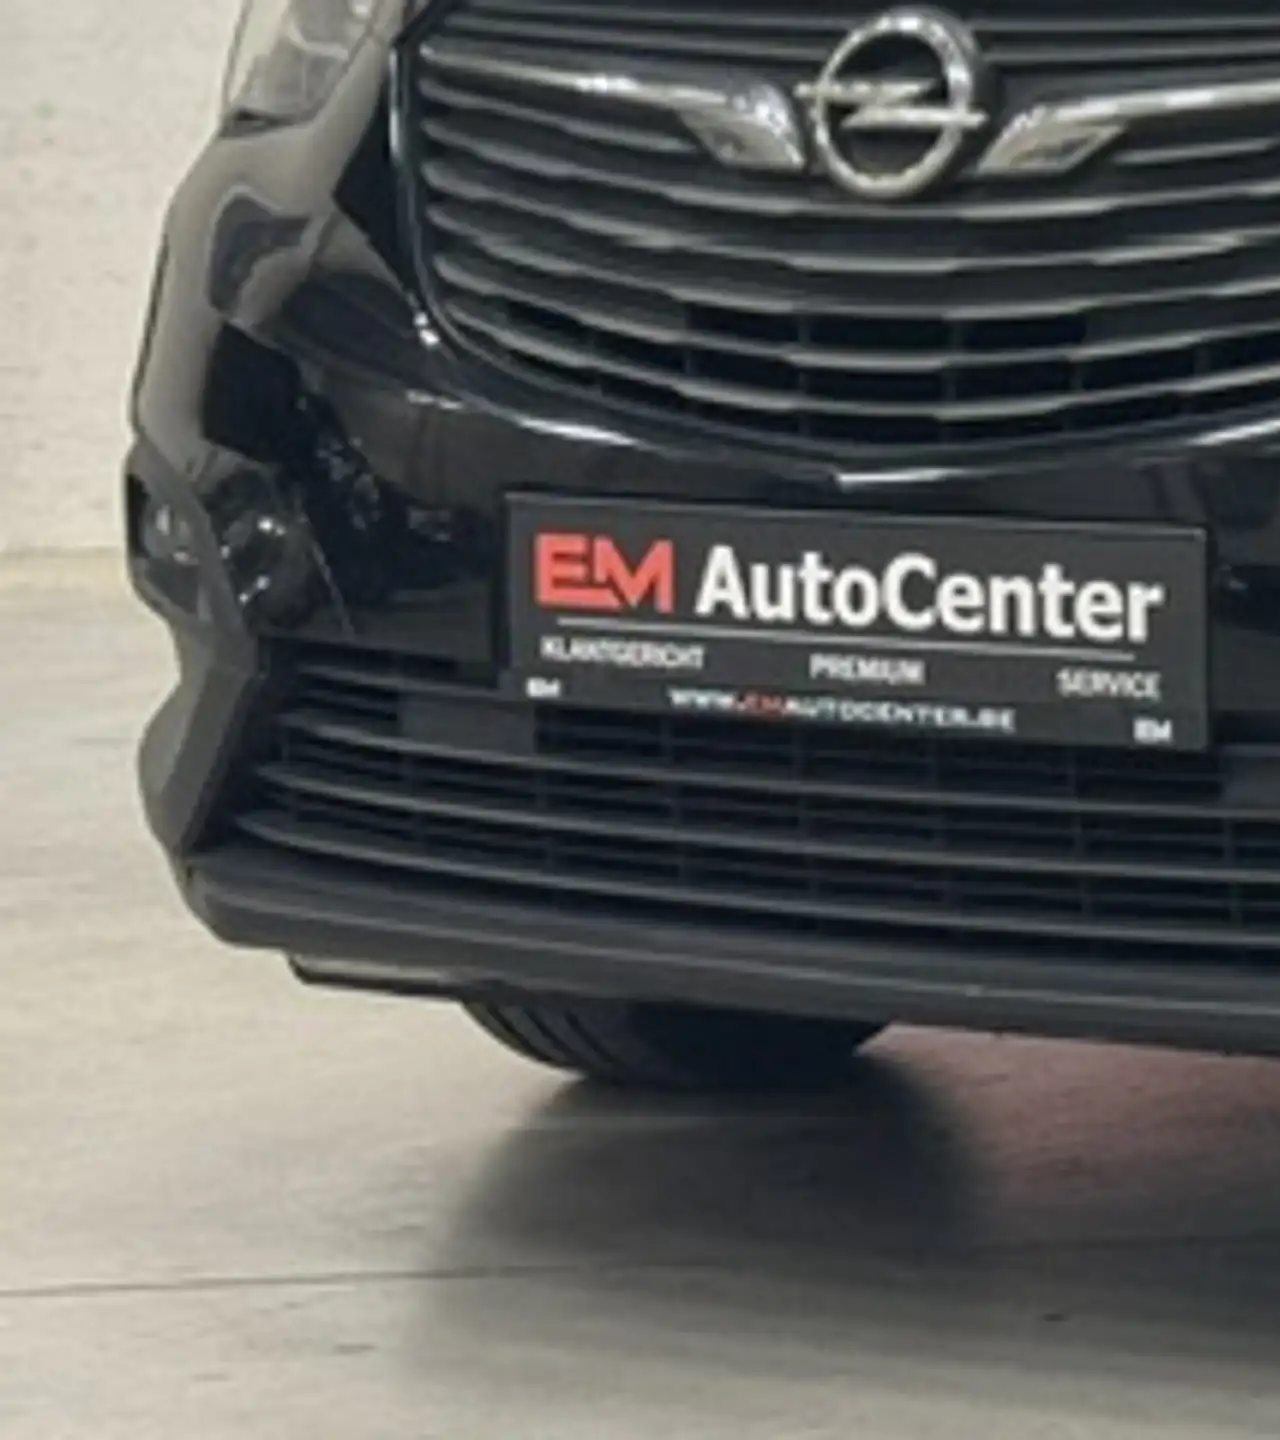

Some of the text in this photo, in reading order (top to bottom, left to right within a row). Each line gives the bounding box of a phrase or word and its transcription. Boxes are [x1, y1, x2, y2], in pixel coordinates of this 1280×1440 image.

[533, 530, 1165, 643] EM AutoCenter
[809, 652, 926, 686] PREMIUM
[1056, 667, 1162, 701] SERVICE
